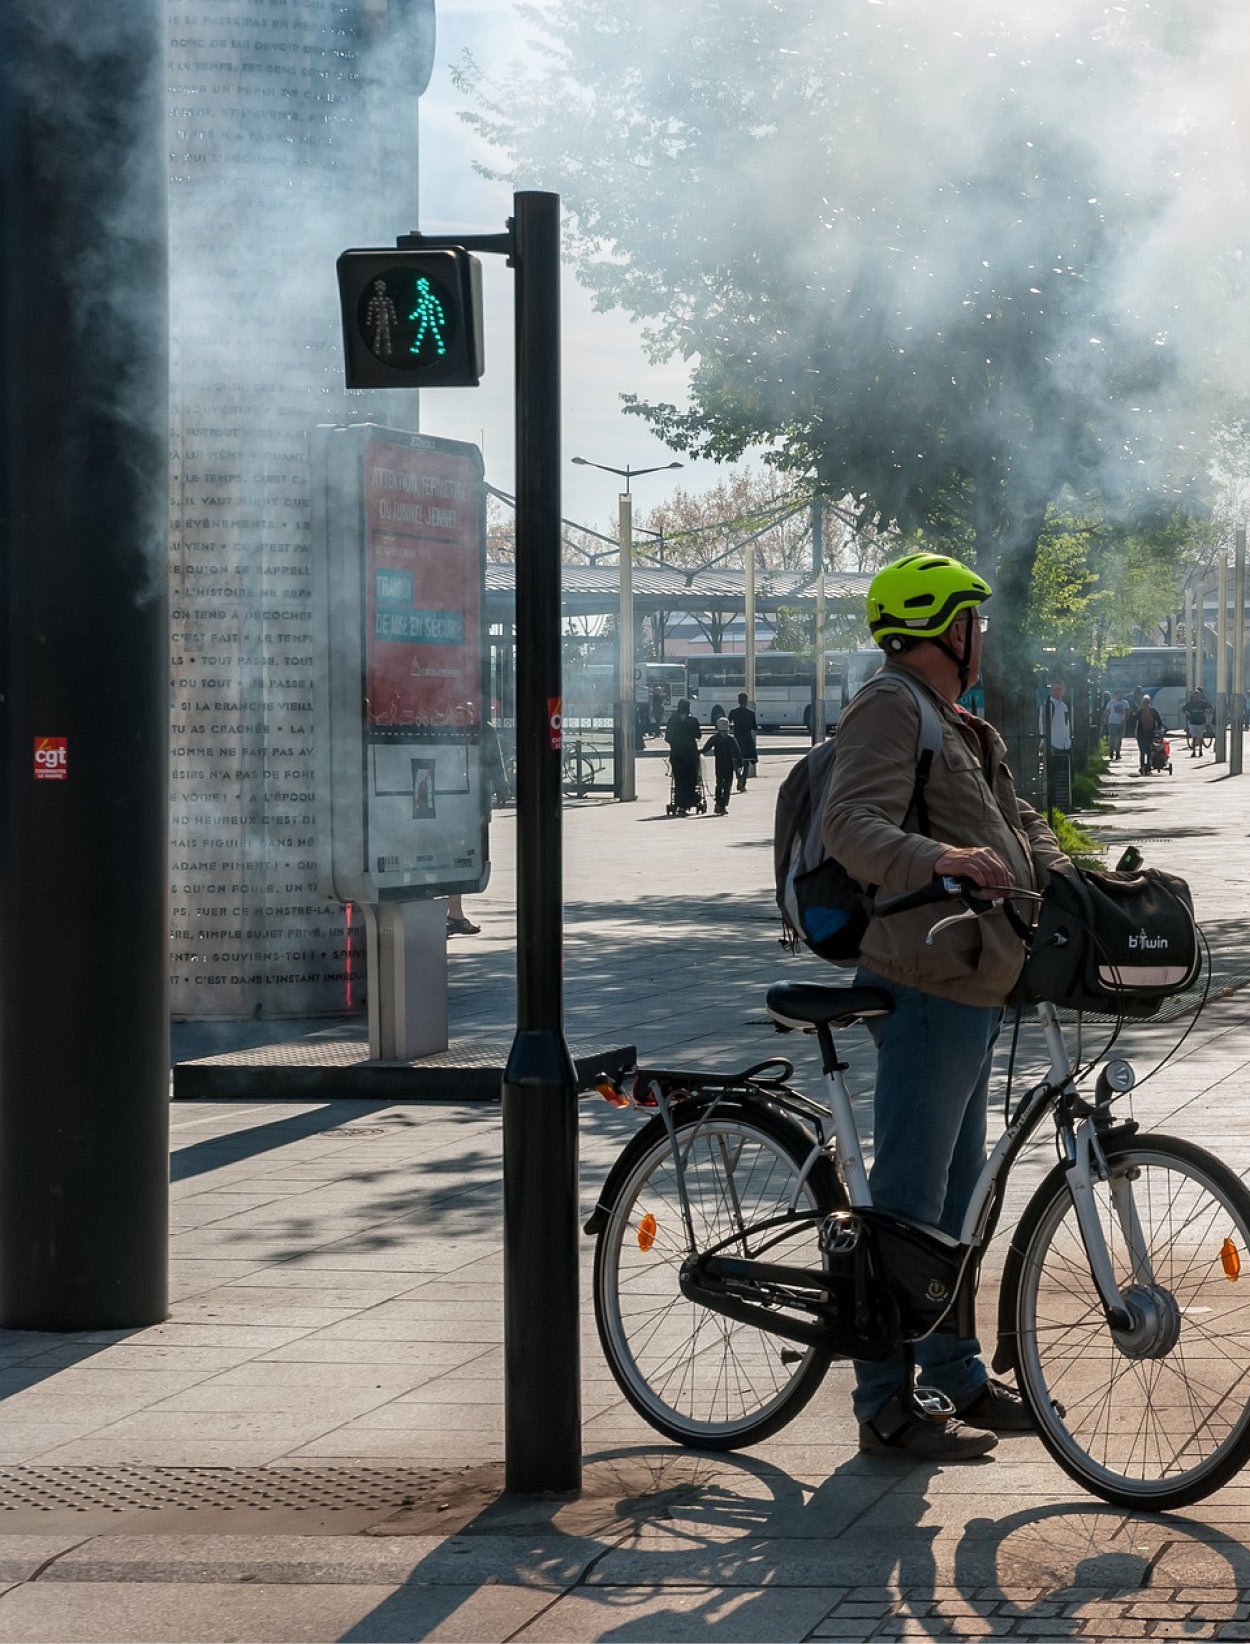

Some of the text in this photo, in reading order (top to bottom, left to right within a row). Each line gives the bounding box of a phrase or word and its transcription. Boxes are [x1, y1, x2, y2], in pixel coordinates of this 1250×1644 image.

[210, 39, 227, 49] DE
[185, 542, 216, 552] VENT
[185, 565, 229, 575] QU'ON
[186, 587, 254, 598] L'HISTOIRE
[172, 610, 191, 620] ON
[194, 610, 226, 620] TEND
[210, 633, 239, 643] FAIT
[201, 656, 232, 666] TOUT
[284, 656, 313, 666] TOUT
[180, 679, 196, 688] DU
[201, 679, 232, 689] TOUT
[269, 679, 306, 689] PASSE
[181, 702, 192, 711] SI
[195, 702, 211, 712] LA
[214, 702, 273, 712] BRANCHE
[171, 724, 186, 734] TU
[190, 725, 206, 734] AS
[35, 746, 67, 768] cgt
[219, 747, 237, 757] NE
[241, 747, 267, 757] FAIT
[271, 747, 294, 757] PAS
[210, 770, 232, 780] N'A
[236, 770, 257, 780] PAS
[262, 769, 280, 779] DE
[195, 816, 257, 825] HEUREUX
[261, 815, 298, 825] C'EST
[183, 884, 226, 894] QU'ON
[286, 884, 304, 893] UN
[232, 907, 249, 916] CE
[198, 929, 242, 939] SIMPLE
[246, 928, 282, 938] SUJET
[195, 975, 227, 985] C'EST
[231, 975, 262, 985] DANS
[266, 973, 320, 985] L'INSTANT
